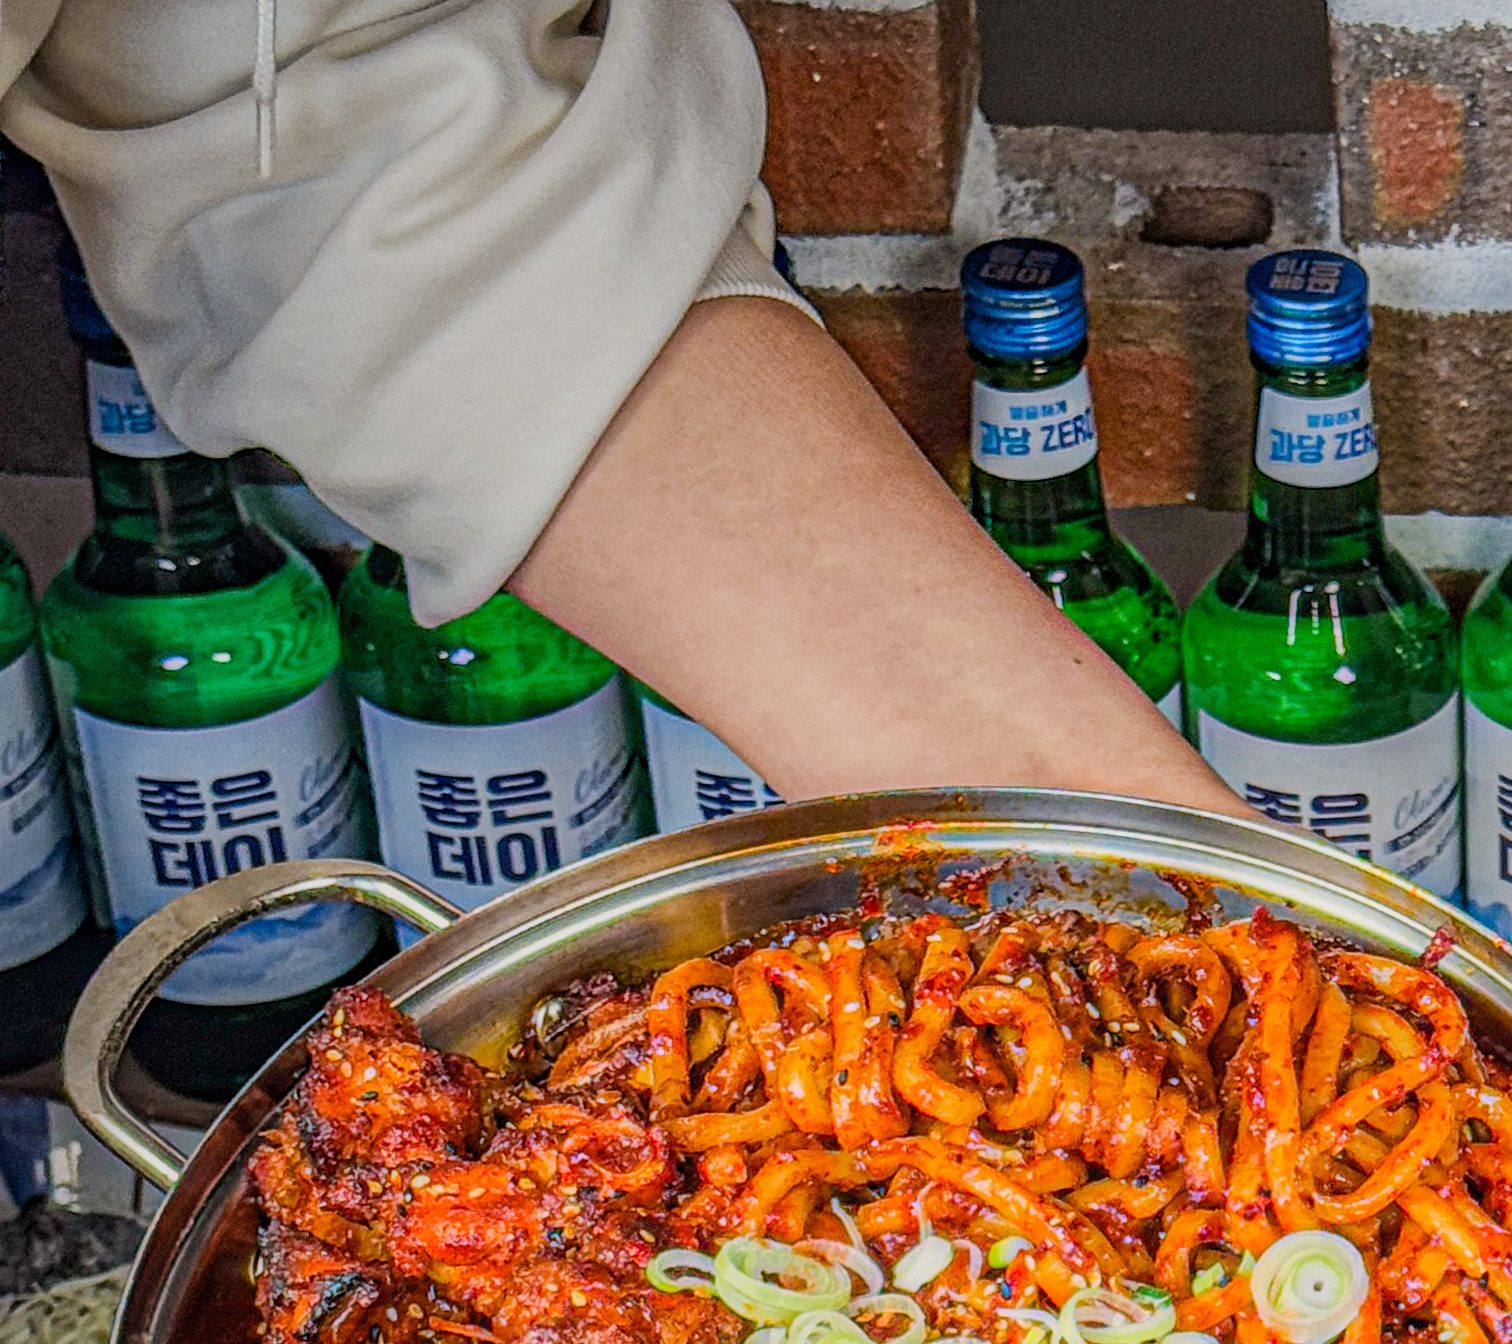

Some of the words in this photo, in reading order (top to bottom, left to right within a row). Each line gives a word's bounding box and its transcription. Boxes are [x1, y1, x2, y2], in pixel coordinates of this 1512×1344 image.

[979, 420, 1031, 456] 과당
[1270, 428, 1325, 464] 과당
[137, 770, 279, 834] 좋은
[416, 769, 554, 830] 좋은
[695, 769, 786, 820] 좋
[150, 826, 288, 888] 데이
[427, 825, 560, 886] 데이
